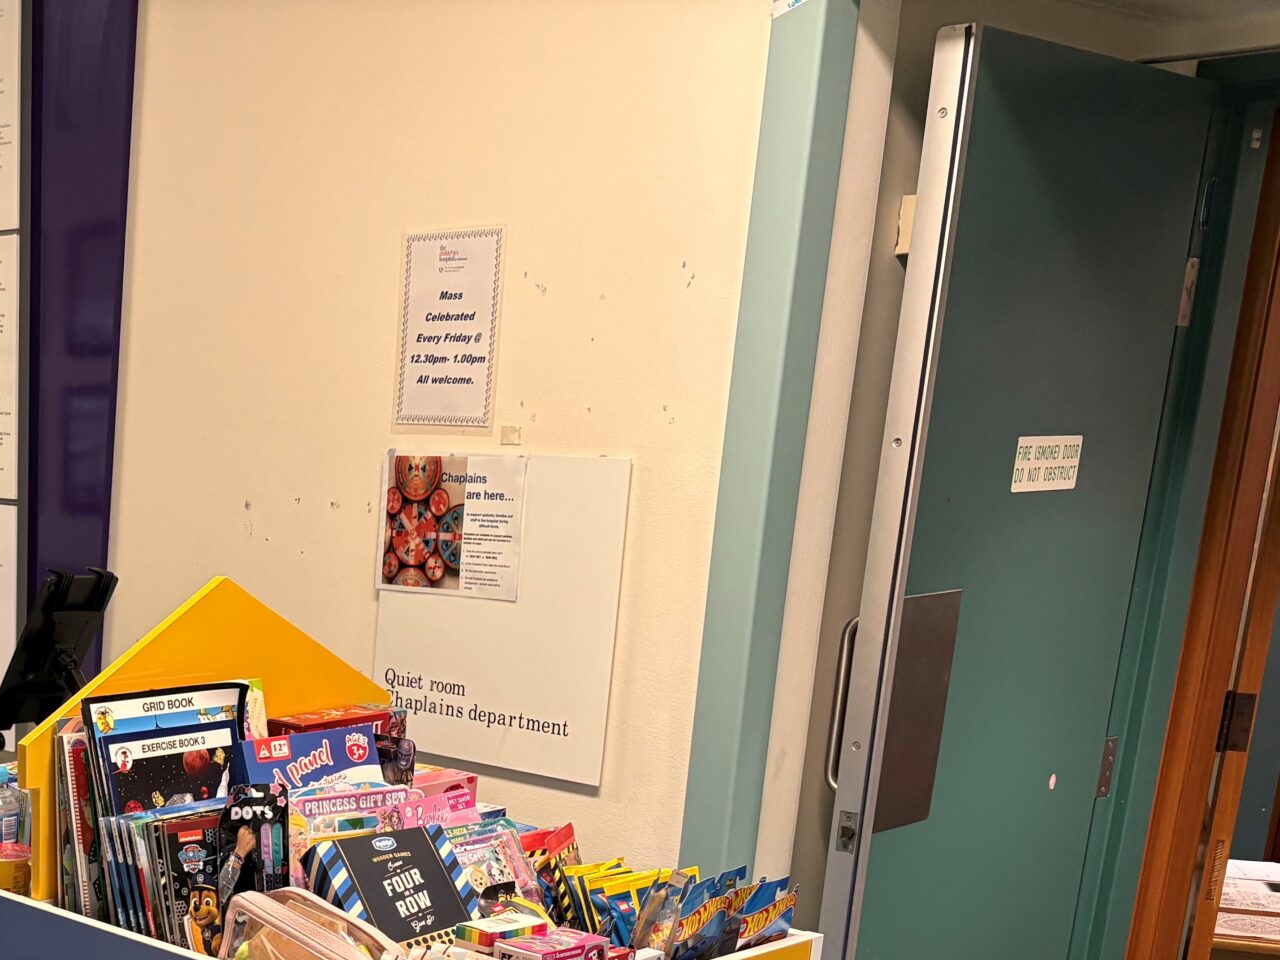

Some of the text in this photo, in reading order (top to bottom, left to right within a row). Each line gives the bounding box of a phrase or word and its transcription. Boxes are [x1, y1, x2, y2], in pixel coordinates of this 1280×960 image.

[439, 290, 463, 300] Mass
[425, 311, 475, 322] Celebrated
[416, 332, 483, 344] Every Friday @
[410, 354, 486, 365] 12.30pm- 1.00pm
[416, 375, 474, 384] All welcome.
[1018, 444, 1080, 461] FIRE (SMOKE) DOOR
[441, 472, 487, 486] Chaplains
[1014, 465, 1076, 483] DO NOT OBSTRUCT
[466, 490, 514, 502] are here...
[385, 667, 466, 696] Quiet room
[142, 697, 195, 713] GRID BOOK
[468, 704, 569, 738] department
[142, 741, 178, 753] EXERCISE
[178, 738, 200, 748] BOOK
[201, 736, 206, 744] 3
[346, 733, 368, 745] AGES
[351, 746, 364, 758] 3+
[287, 739, 333, 787] panel
[304, 790, 407, 814] PRINCESS GIFT SET
[231, 806, 273, 820] DOTS
[416, 804, 449, 826] Barbie
[372, 854, 393, 862] WOODEN
[383, 868, 424, 896] FOUR
[395, 890, 432, 918] ROW
[681, 913, 701, 941] HOT
[699, 898, 729, 926] WHEELS
[747, 910, 768, 938] HOT
[766, 894, 796, 921] WHEELS
